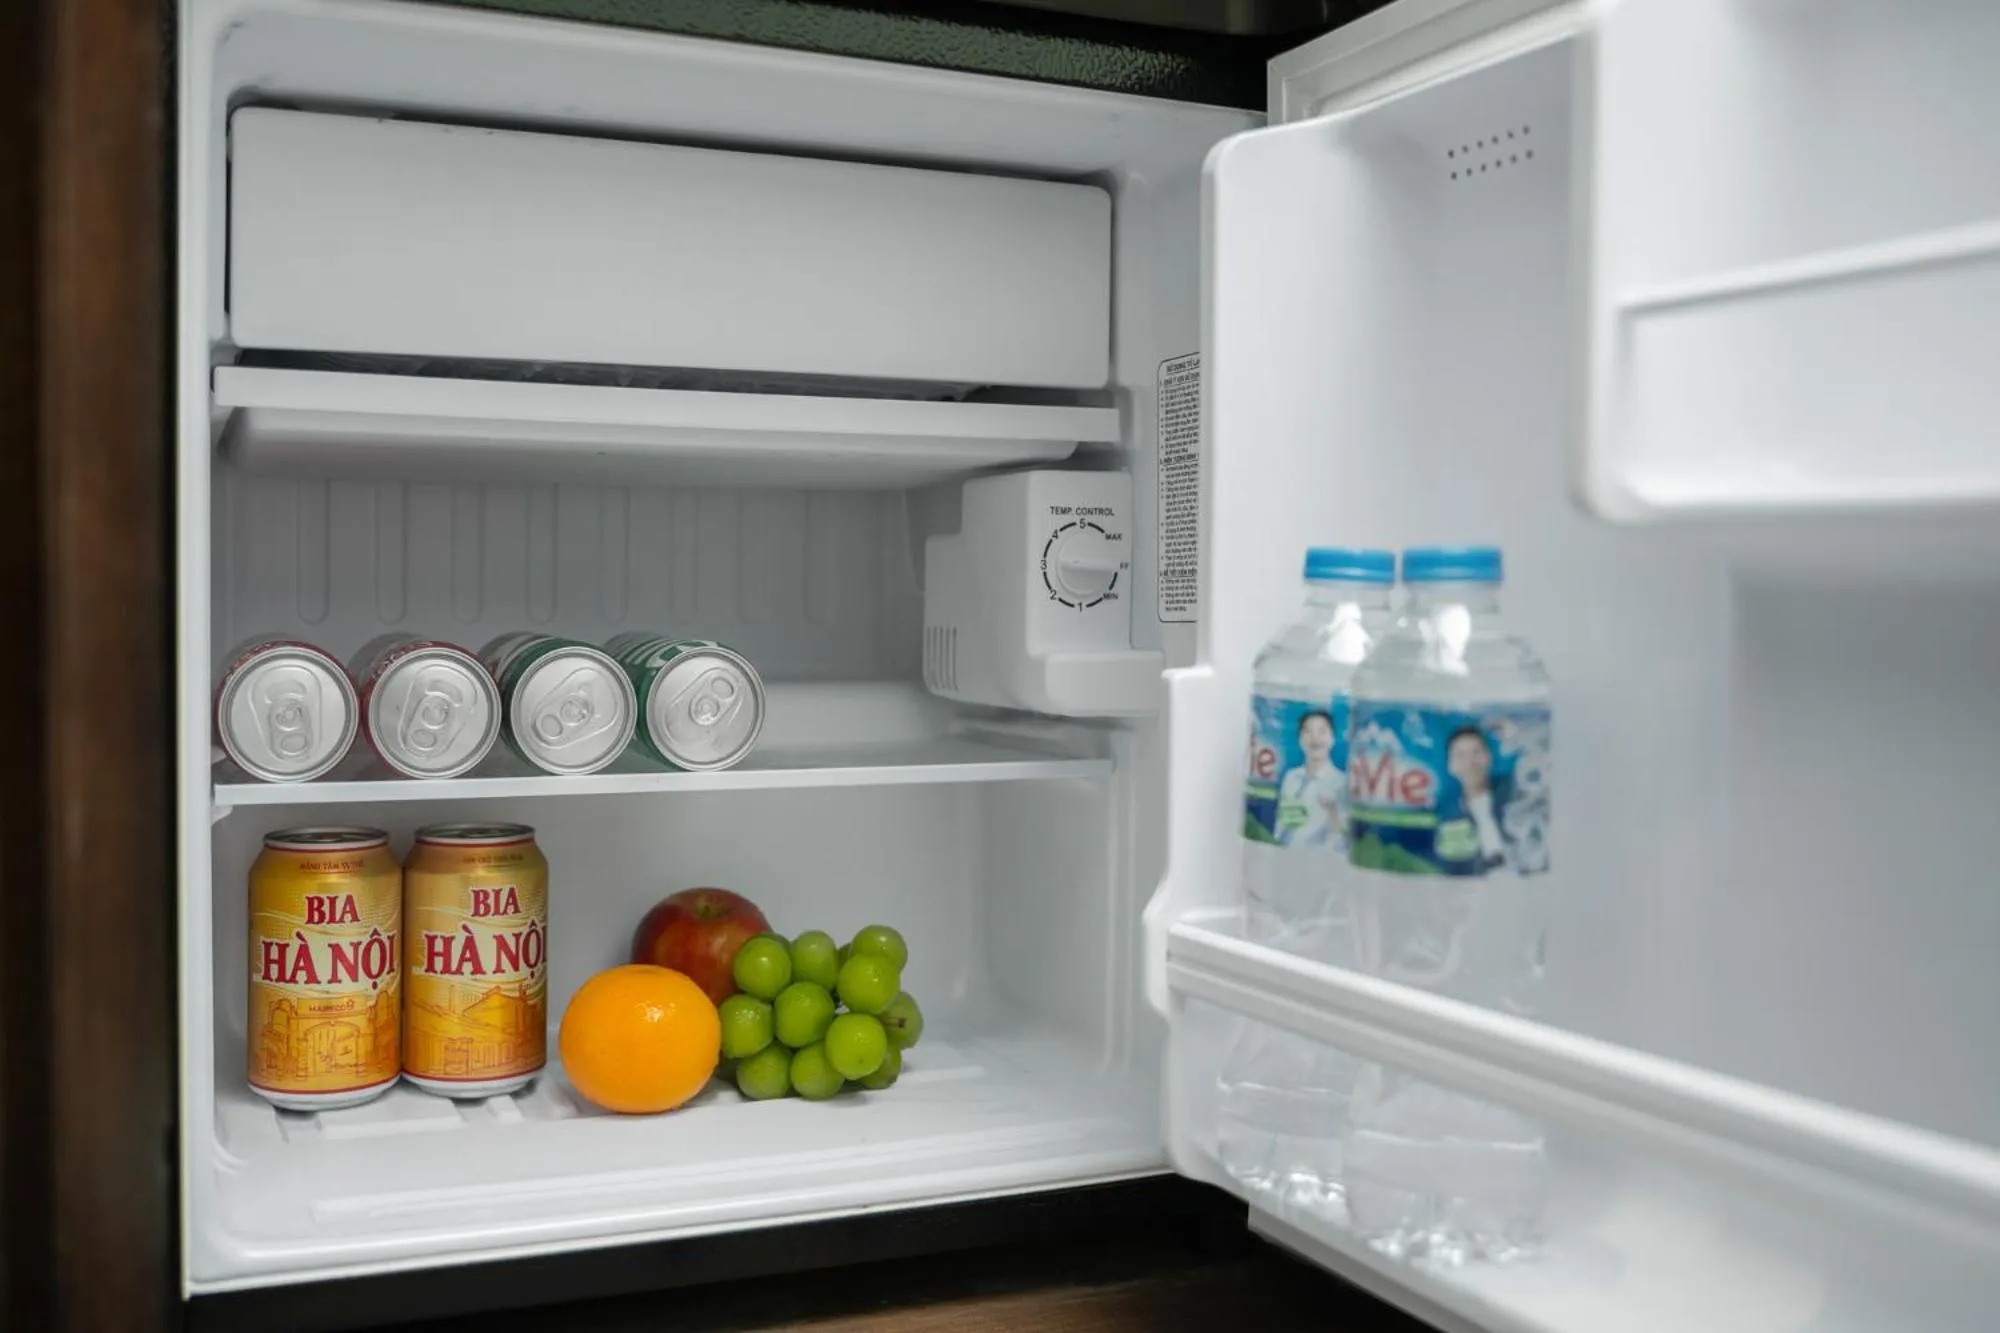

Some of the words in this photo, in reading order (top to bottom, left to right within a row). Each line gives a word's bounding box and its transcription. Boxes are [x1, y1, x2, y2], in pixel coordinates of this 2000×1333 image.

[1076, 507, 1114, 517] CONTROL
[1080, 518, 1086, 529] 5
[1052, 529, 1059, 540] 4
[1105, 533, 1122, 541] MAX
[1040, 559, 1048, 571] 3
[1049, 589, 1057, 601] 2
[471, 887, 521, 917] BIA
[305, 895, 360, 925] BIA
[424, 924, 487, 976] HÀ
[492, 919, 547, 979] NỘI
[261, 931, 321, 984] HÀ
[328, 928, 397, 990] NỘI
